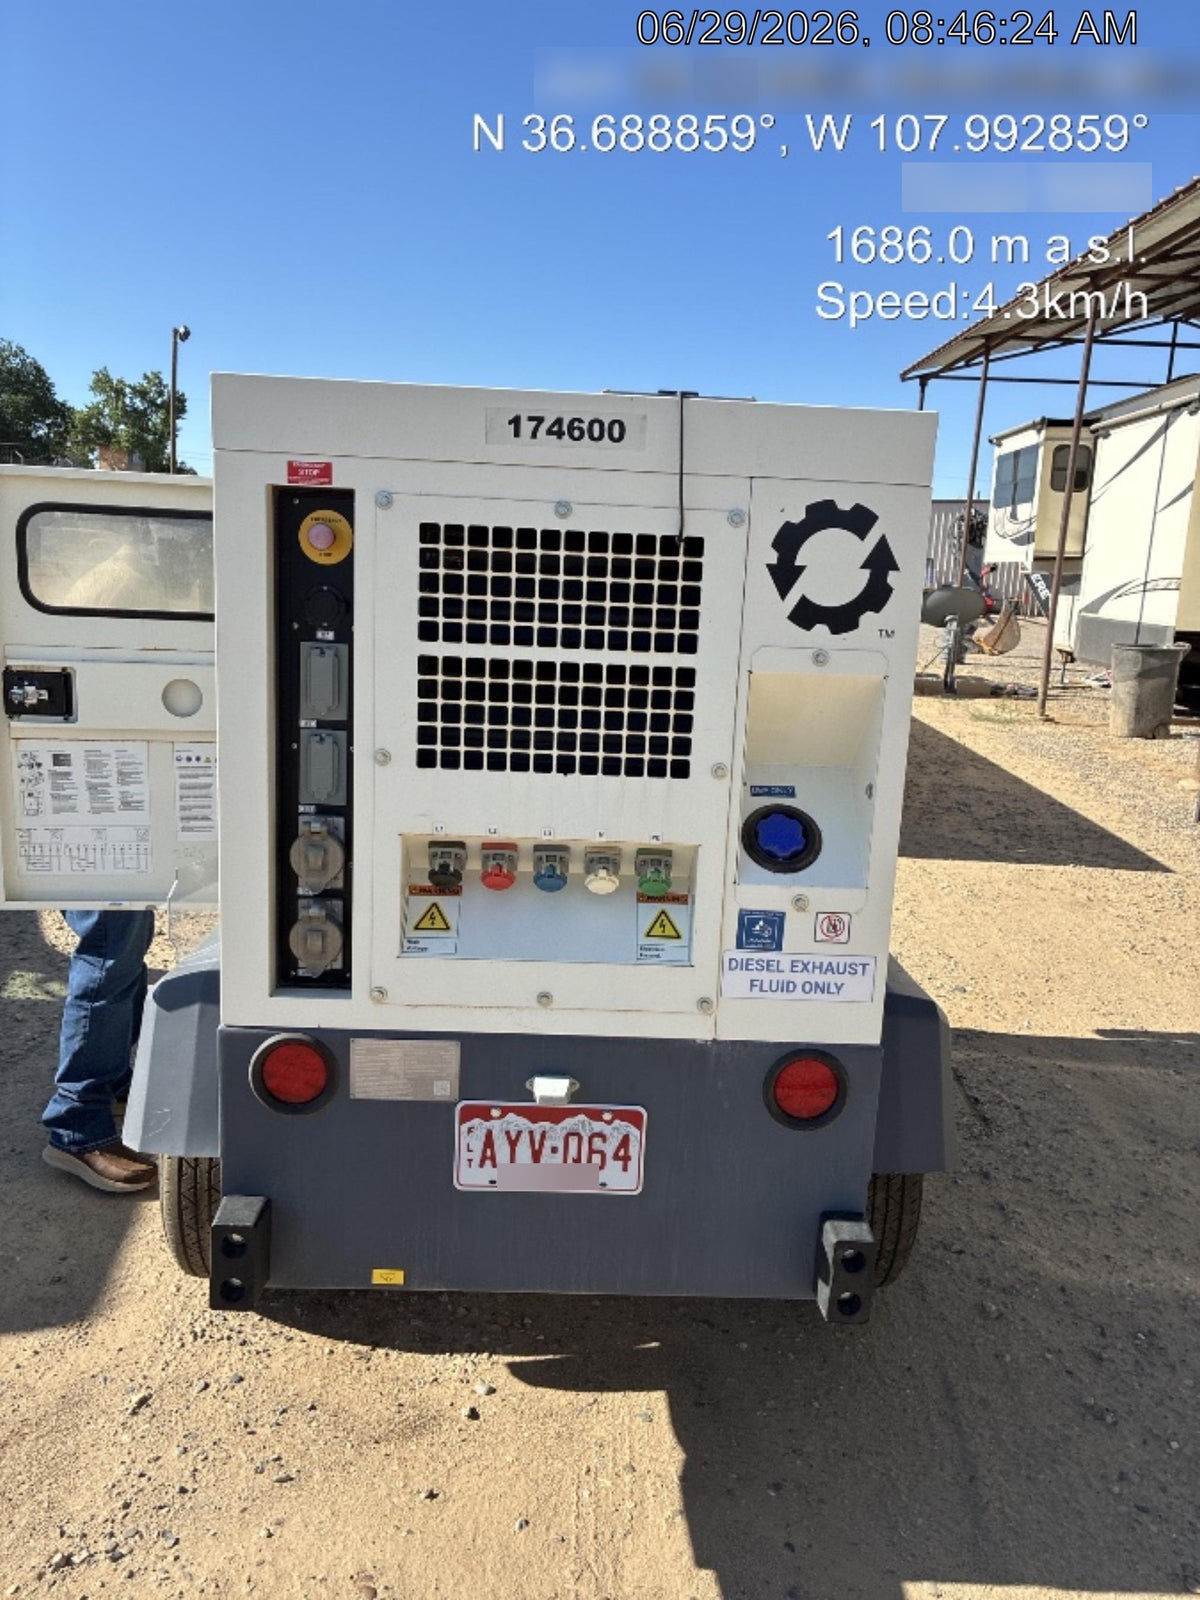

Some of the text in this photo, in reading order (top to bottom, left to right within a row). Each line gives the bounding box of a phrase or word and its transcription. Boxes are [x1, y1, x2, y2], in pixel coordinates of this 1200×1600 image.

[508, 414, 626, 443] 174600
[878, 629, 895, 638] TM
[728, 958, 870, 976] DIESEL EXHAUST
[749, 979, 845, 995] FLUID ONLY
